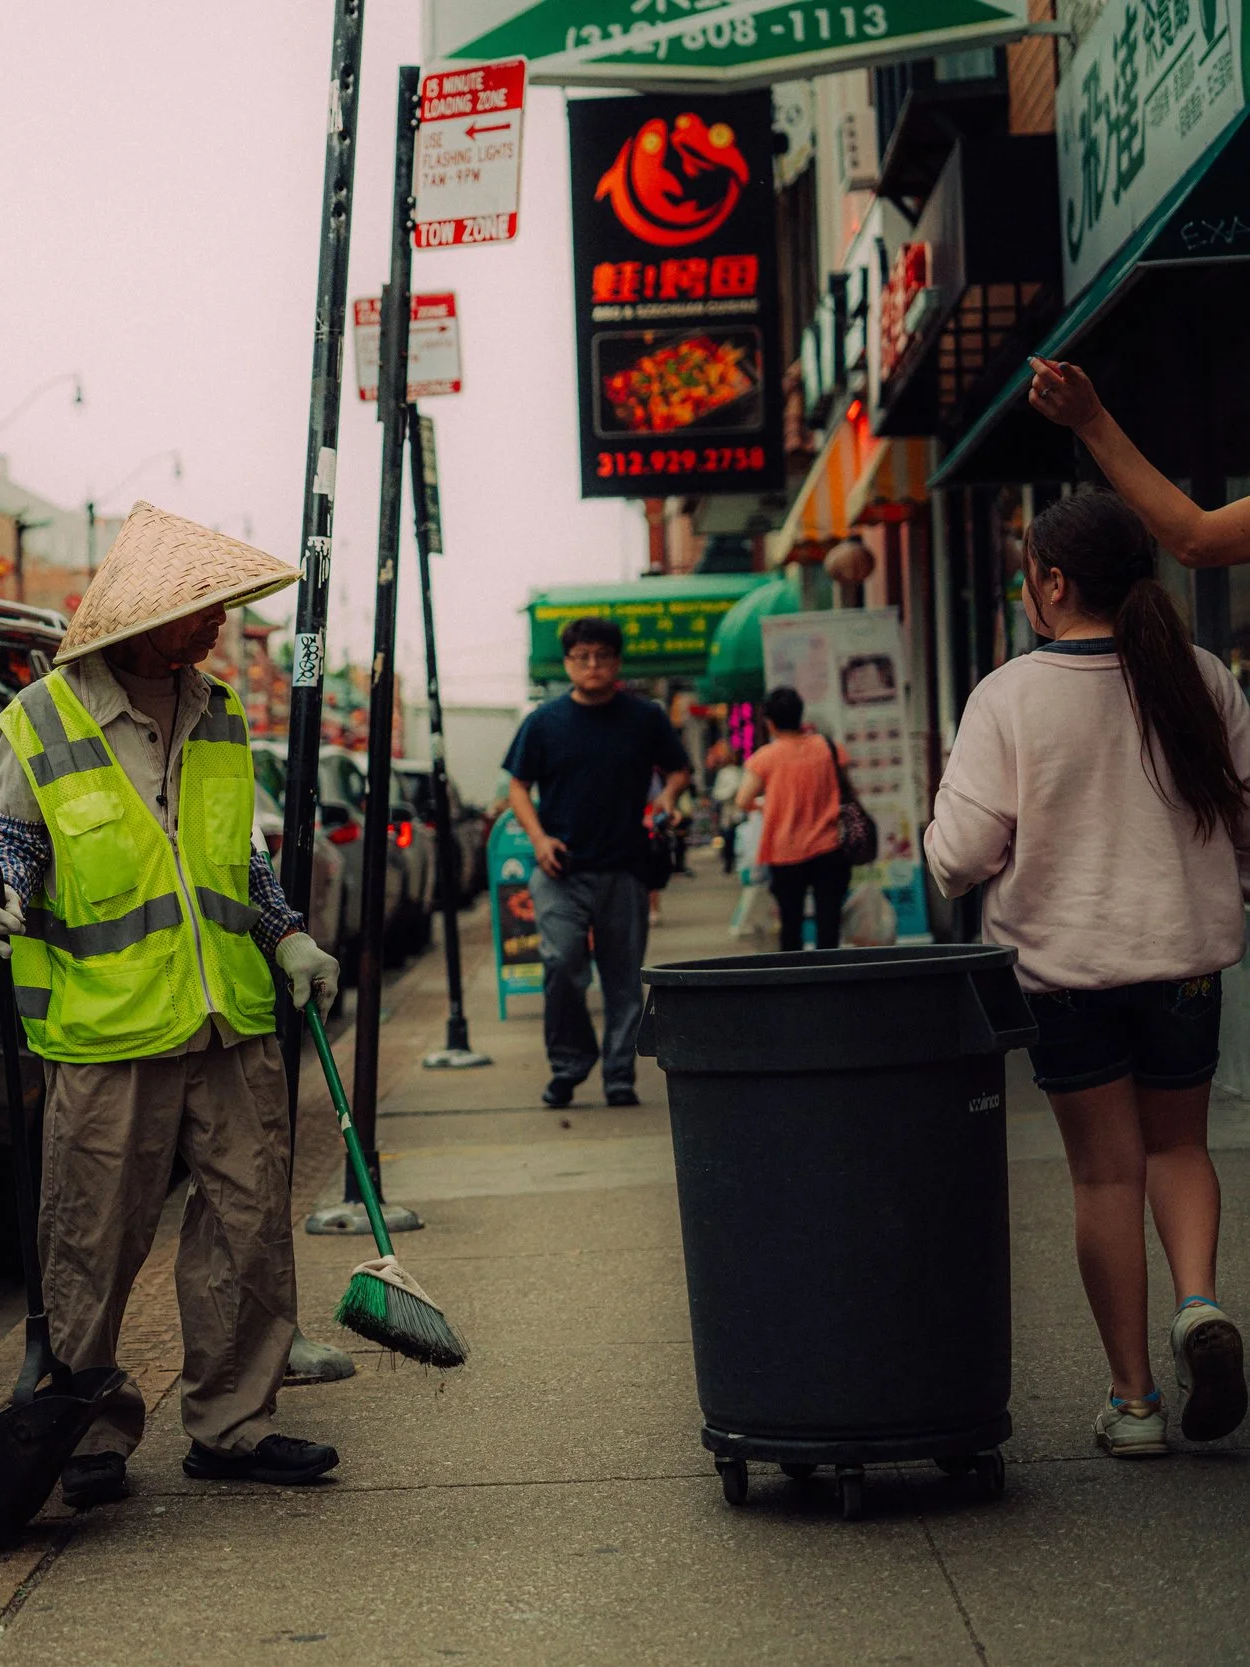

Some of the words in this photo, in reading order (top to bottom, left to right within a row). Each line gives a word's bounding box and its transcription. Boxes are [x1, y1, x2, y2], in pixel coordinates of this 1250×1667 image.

[425, 78, 440, 98] 15
[442, 71, 485, 96] MINUTE
[424, 94, 473, 119] LOADING
[476, 88, 508, 112] ZONE
[424, 132, 444, 149] USE
[423, 149, 472, 171] FLASHING
[478, 143, 514, 166] LIGHTS
[418, 221, 456, 247] TOW
[461, 215, 510, 243] ZONE
